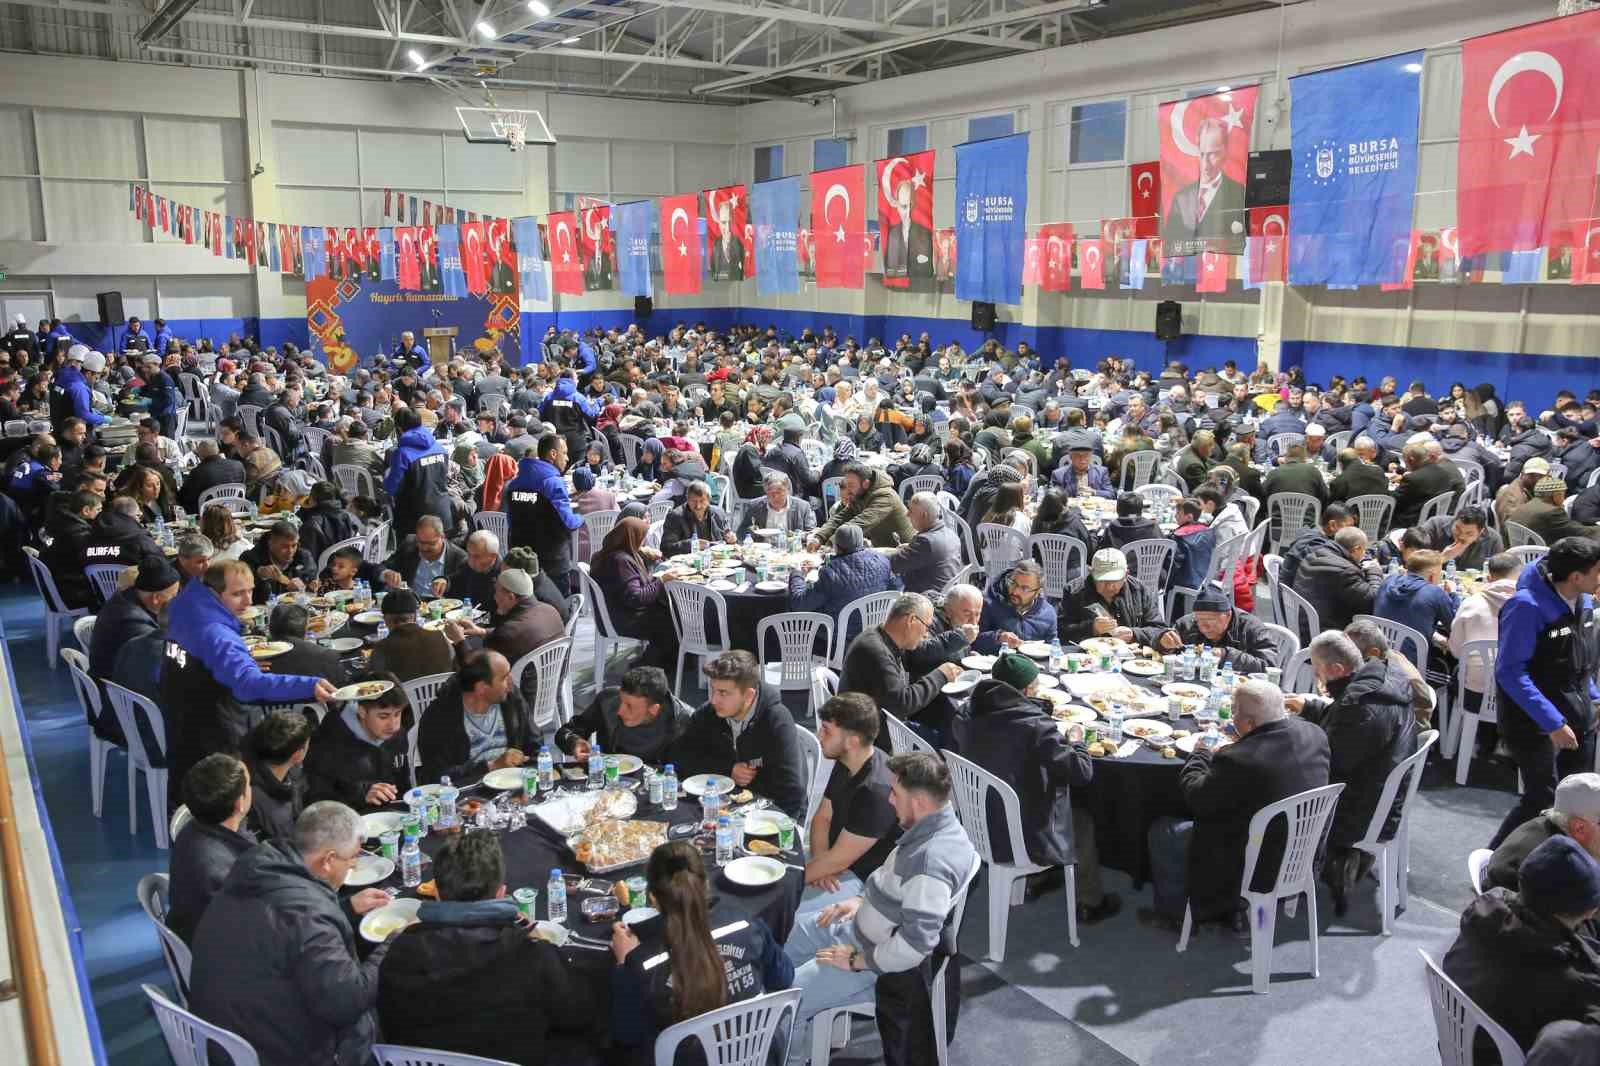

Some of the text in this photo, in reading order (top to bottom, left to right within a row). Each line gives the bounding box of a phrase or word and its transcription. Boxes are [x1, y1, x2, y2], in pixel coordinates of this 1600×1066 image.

[1349, 138, 1398, 155] BURSA
[1348, 150, 1398, 166] BÜYÜKŞEHİR
[1348, 159, 1398, 175] BELEDİYESİ
[86, 546, 121, 557] BURFAŞ
[742, 974, 755, 988] 55
